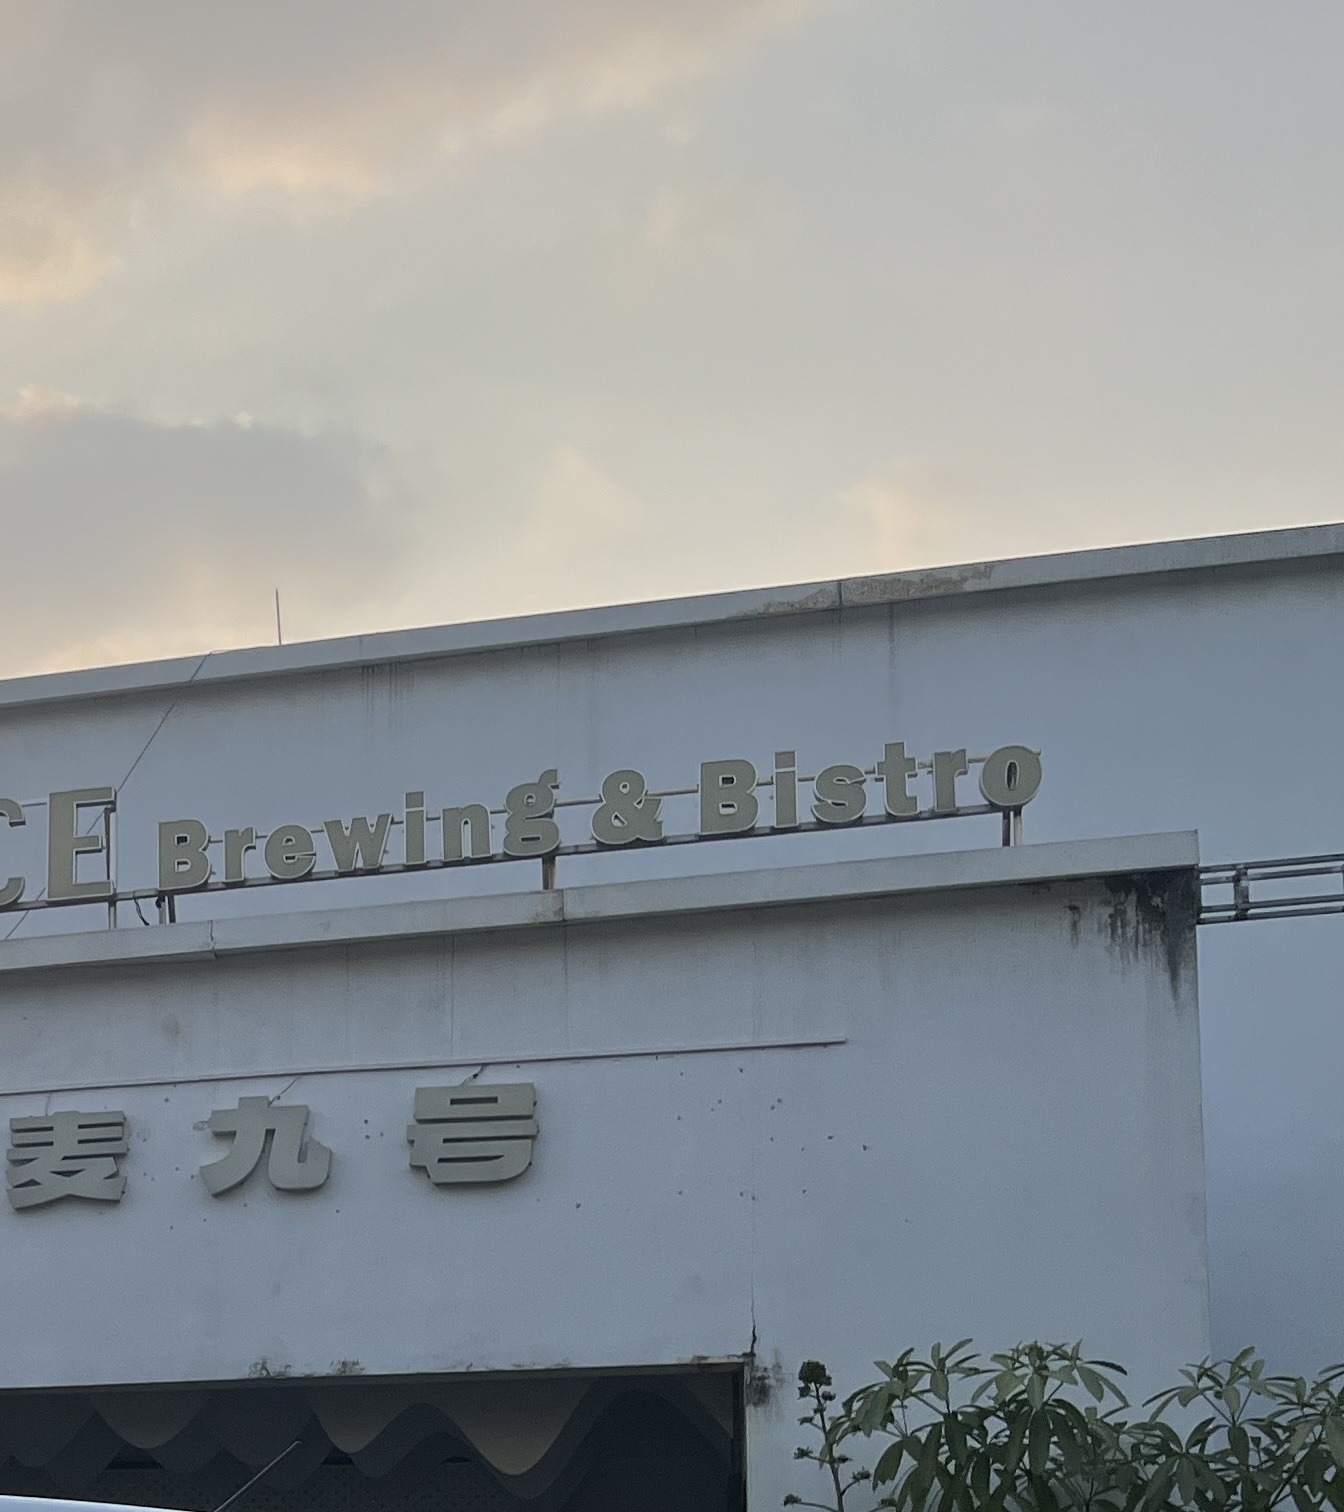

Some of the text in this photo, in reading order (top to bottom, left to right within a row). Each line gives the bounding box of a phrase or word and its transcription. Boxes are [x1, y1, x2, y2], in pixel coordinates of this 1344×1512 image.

[157, 767, 563, 892] Brewing
[589, 768, 665, 847] &
[698, 741, 1044, 837] Bistro
